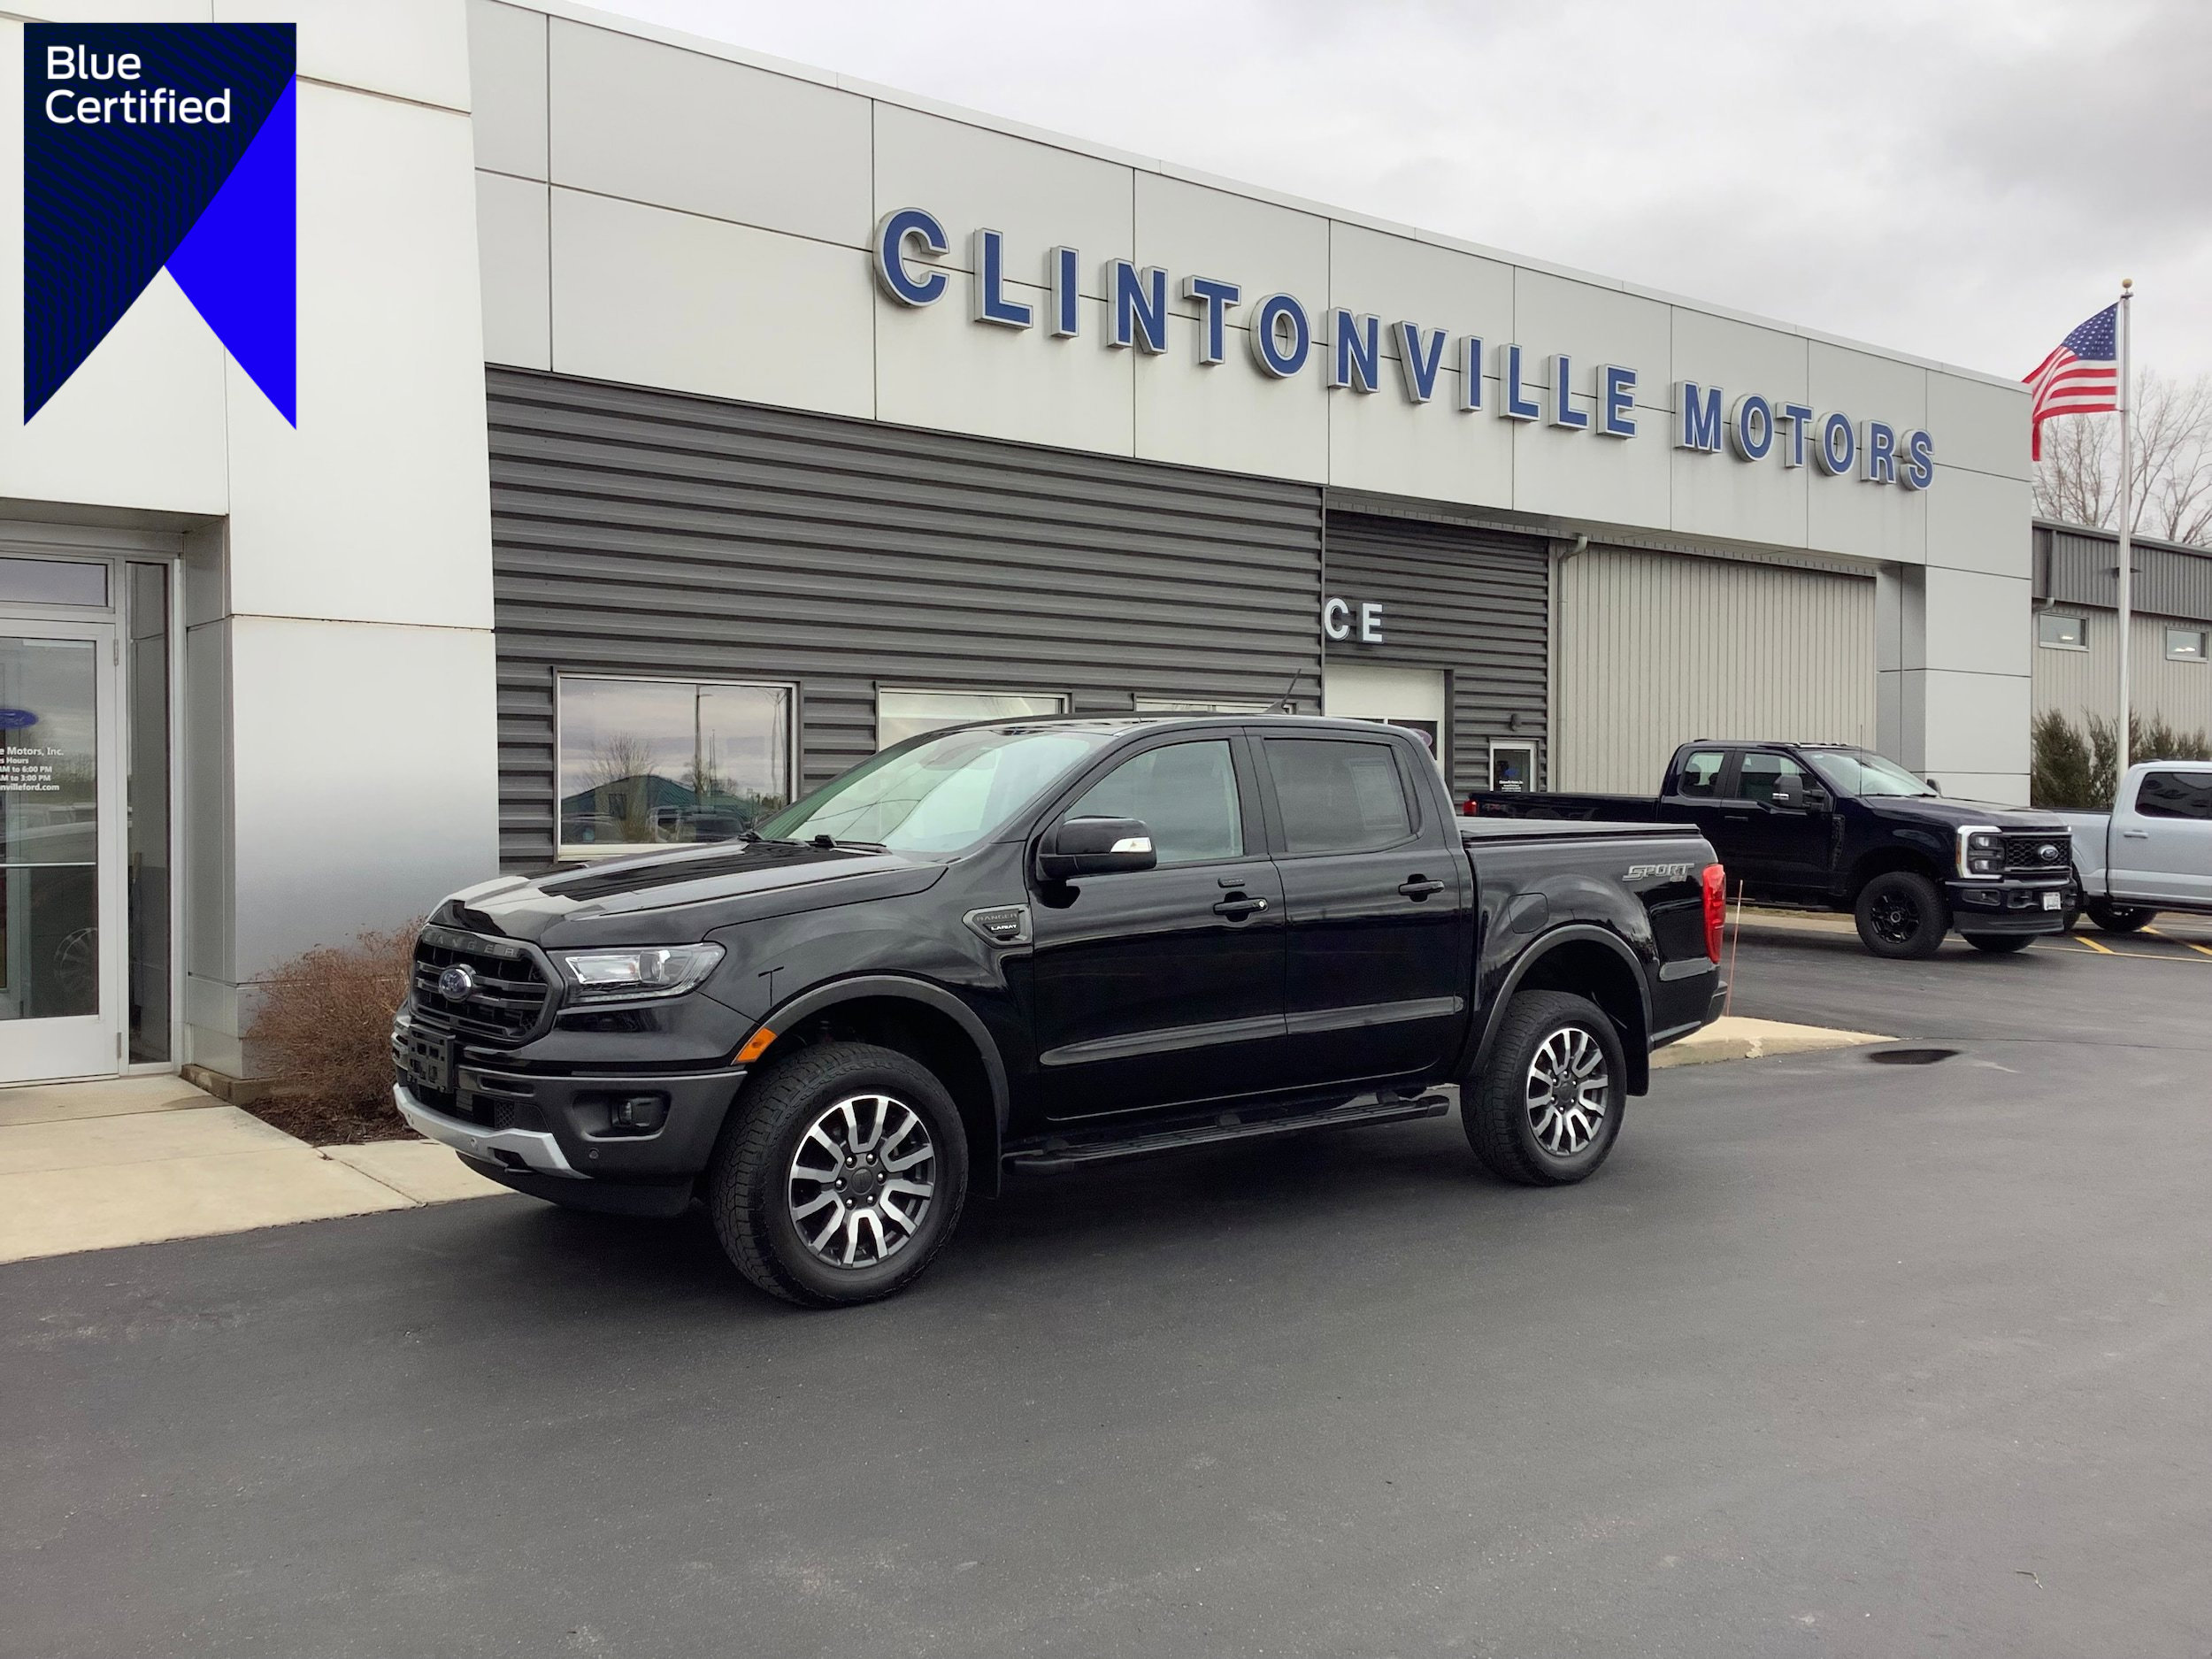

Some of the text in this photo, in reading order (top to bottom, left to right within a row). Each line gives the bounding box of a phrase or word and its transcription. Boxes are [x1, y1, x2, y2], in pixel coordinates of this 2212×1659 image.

[873, 206, 1936, 491] CLINTONVILLE MOTORS
[7, 747, 44, 757] Motors,
[47, 747, 65, 756] Inc.
[1622, 863, 1695, 882] SPORT
[976, 912, 1018, 922] RANGER
